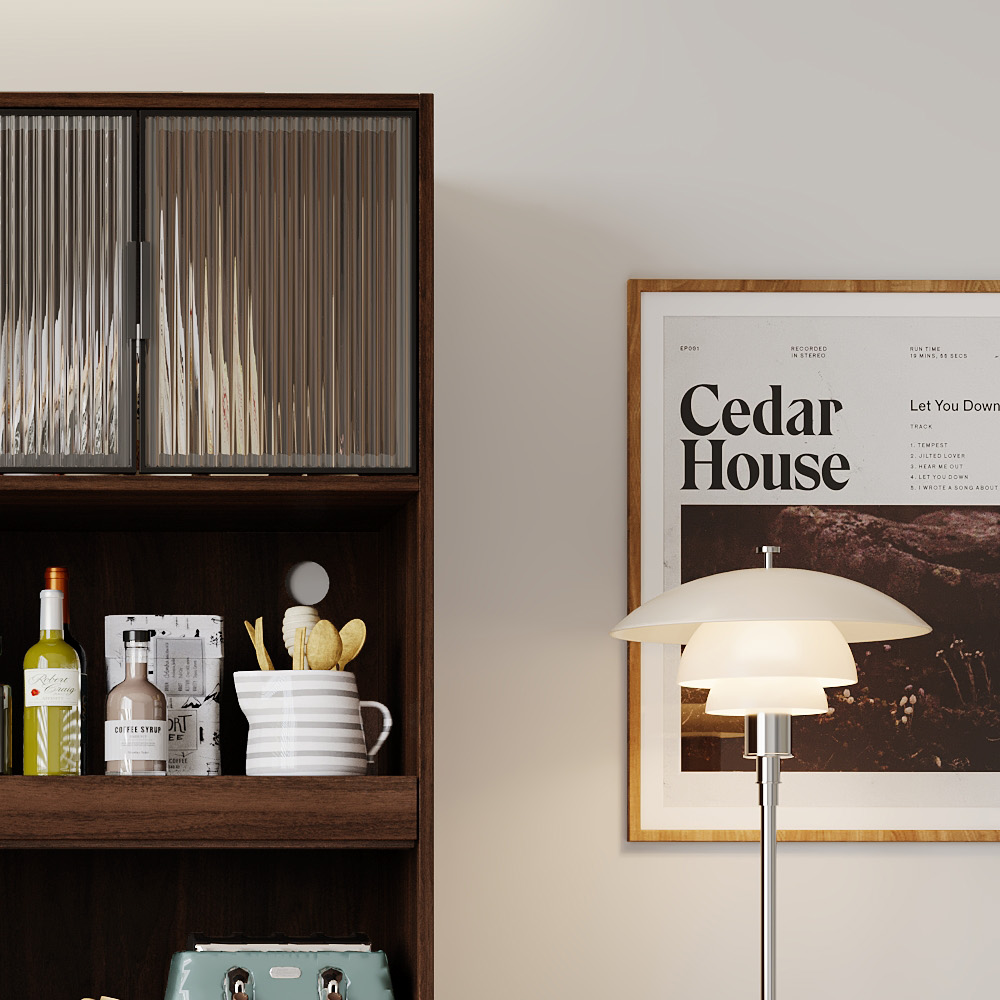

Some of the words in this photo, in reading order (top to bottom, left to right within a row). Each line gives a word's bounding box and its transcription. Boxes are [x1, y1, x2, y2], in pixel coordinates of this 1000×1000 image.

[680, 384, 843, 436] Cedar
[910, 400, 931, 411] Let
[935, 400, 959, 411] You
[964, 400, 1000, 411] Down
[680, 439, 850, 490] House
[32, 673, 68, 685] Robert
[44, 683, 76, 696] Craig
